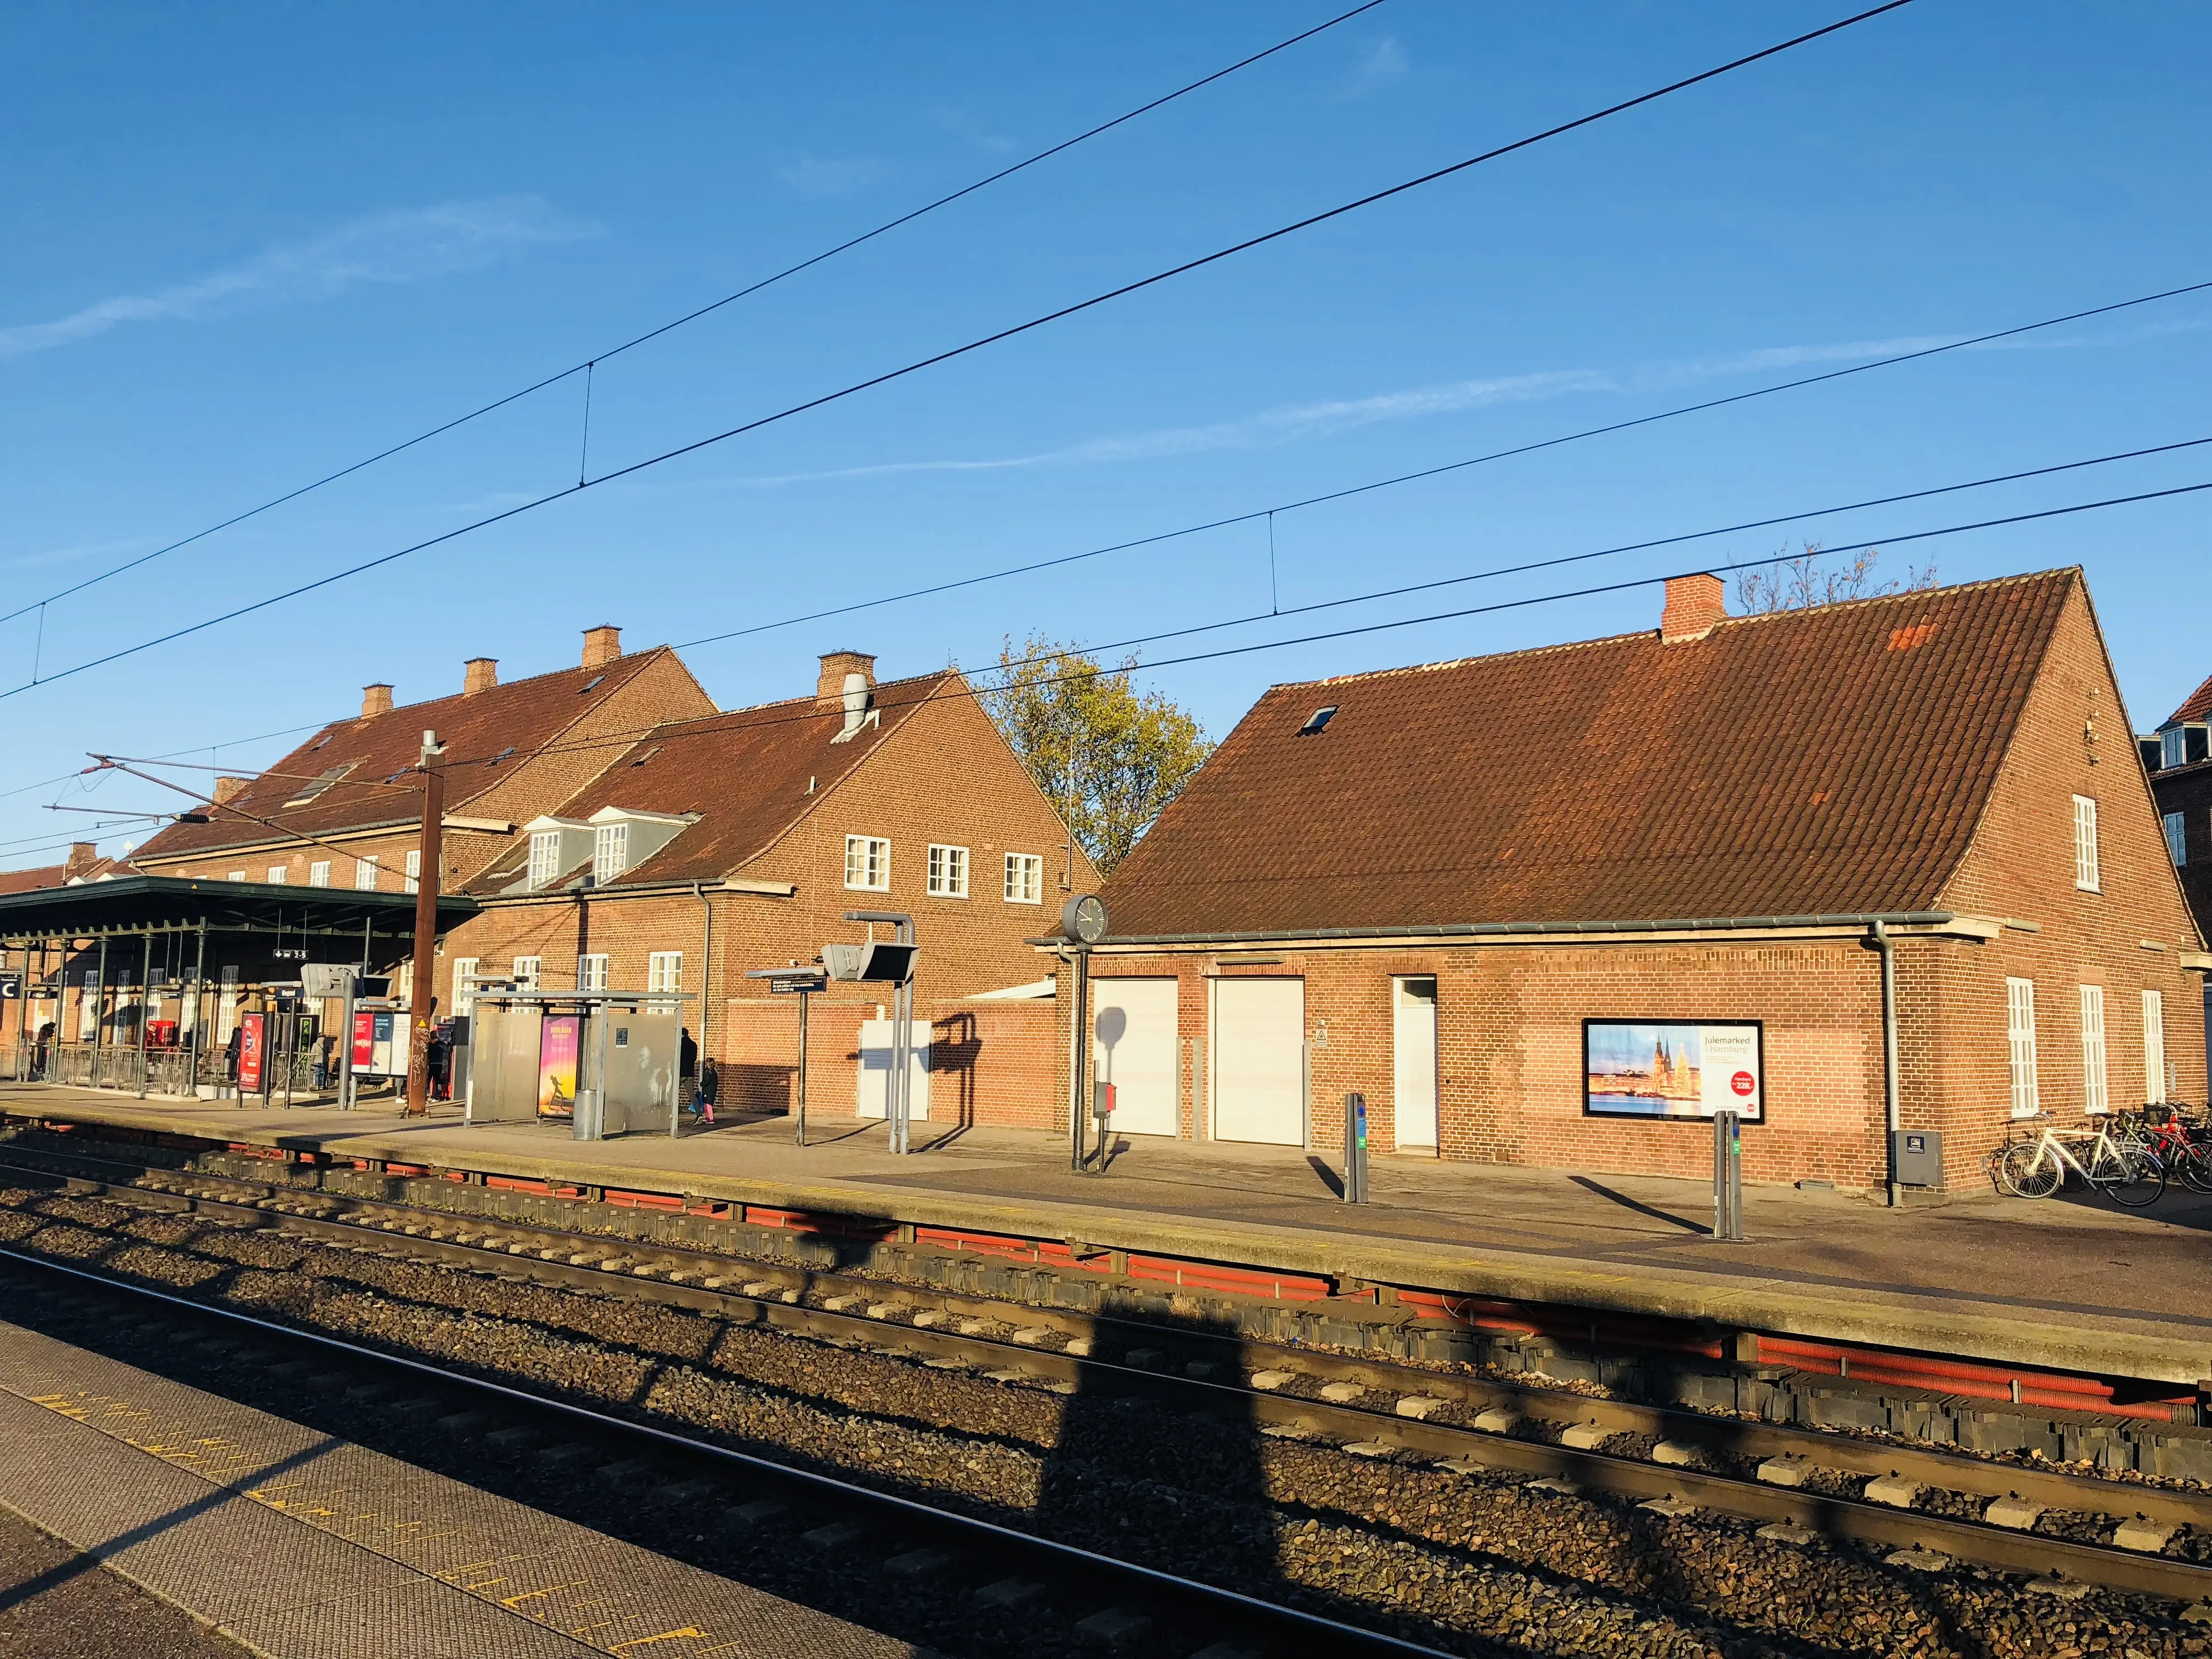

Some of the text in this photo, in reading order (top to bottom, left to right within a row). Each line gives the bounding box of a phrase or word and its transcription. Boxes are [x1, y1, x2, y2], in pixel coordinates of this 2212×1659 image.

[2, 983, 15, 997] C
[1705, 1036, 1750, 1045] Julemarked
[1710, 1046, 1748, 1054] Hamburg
